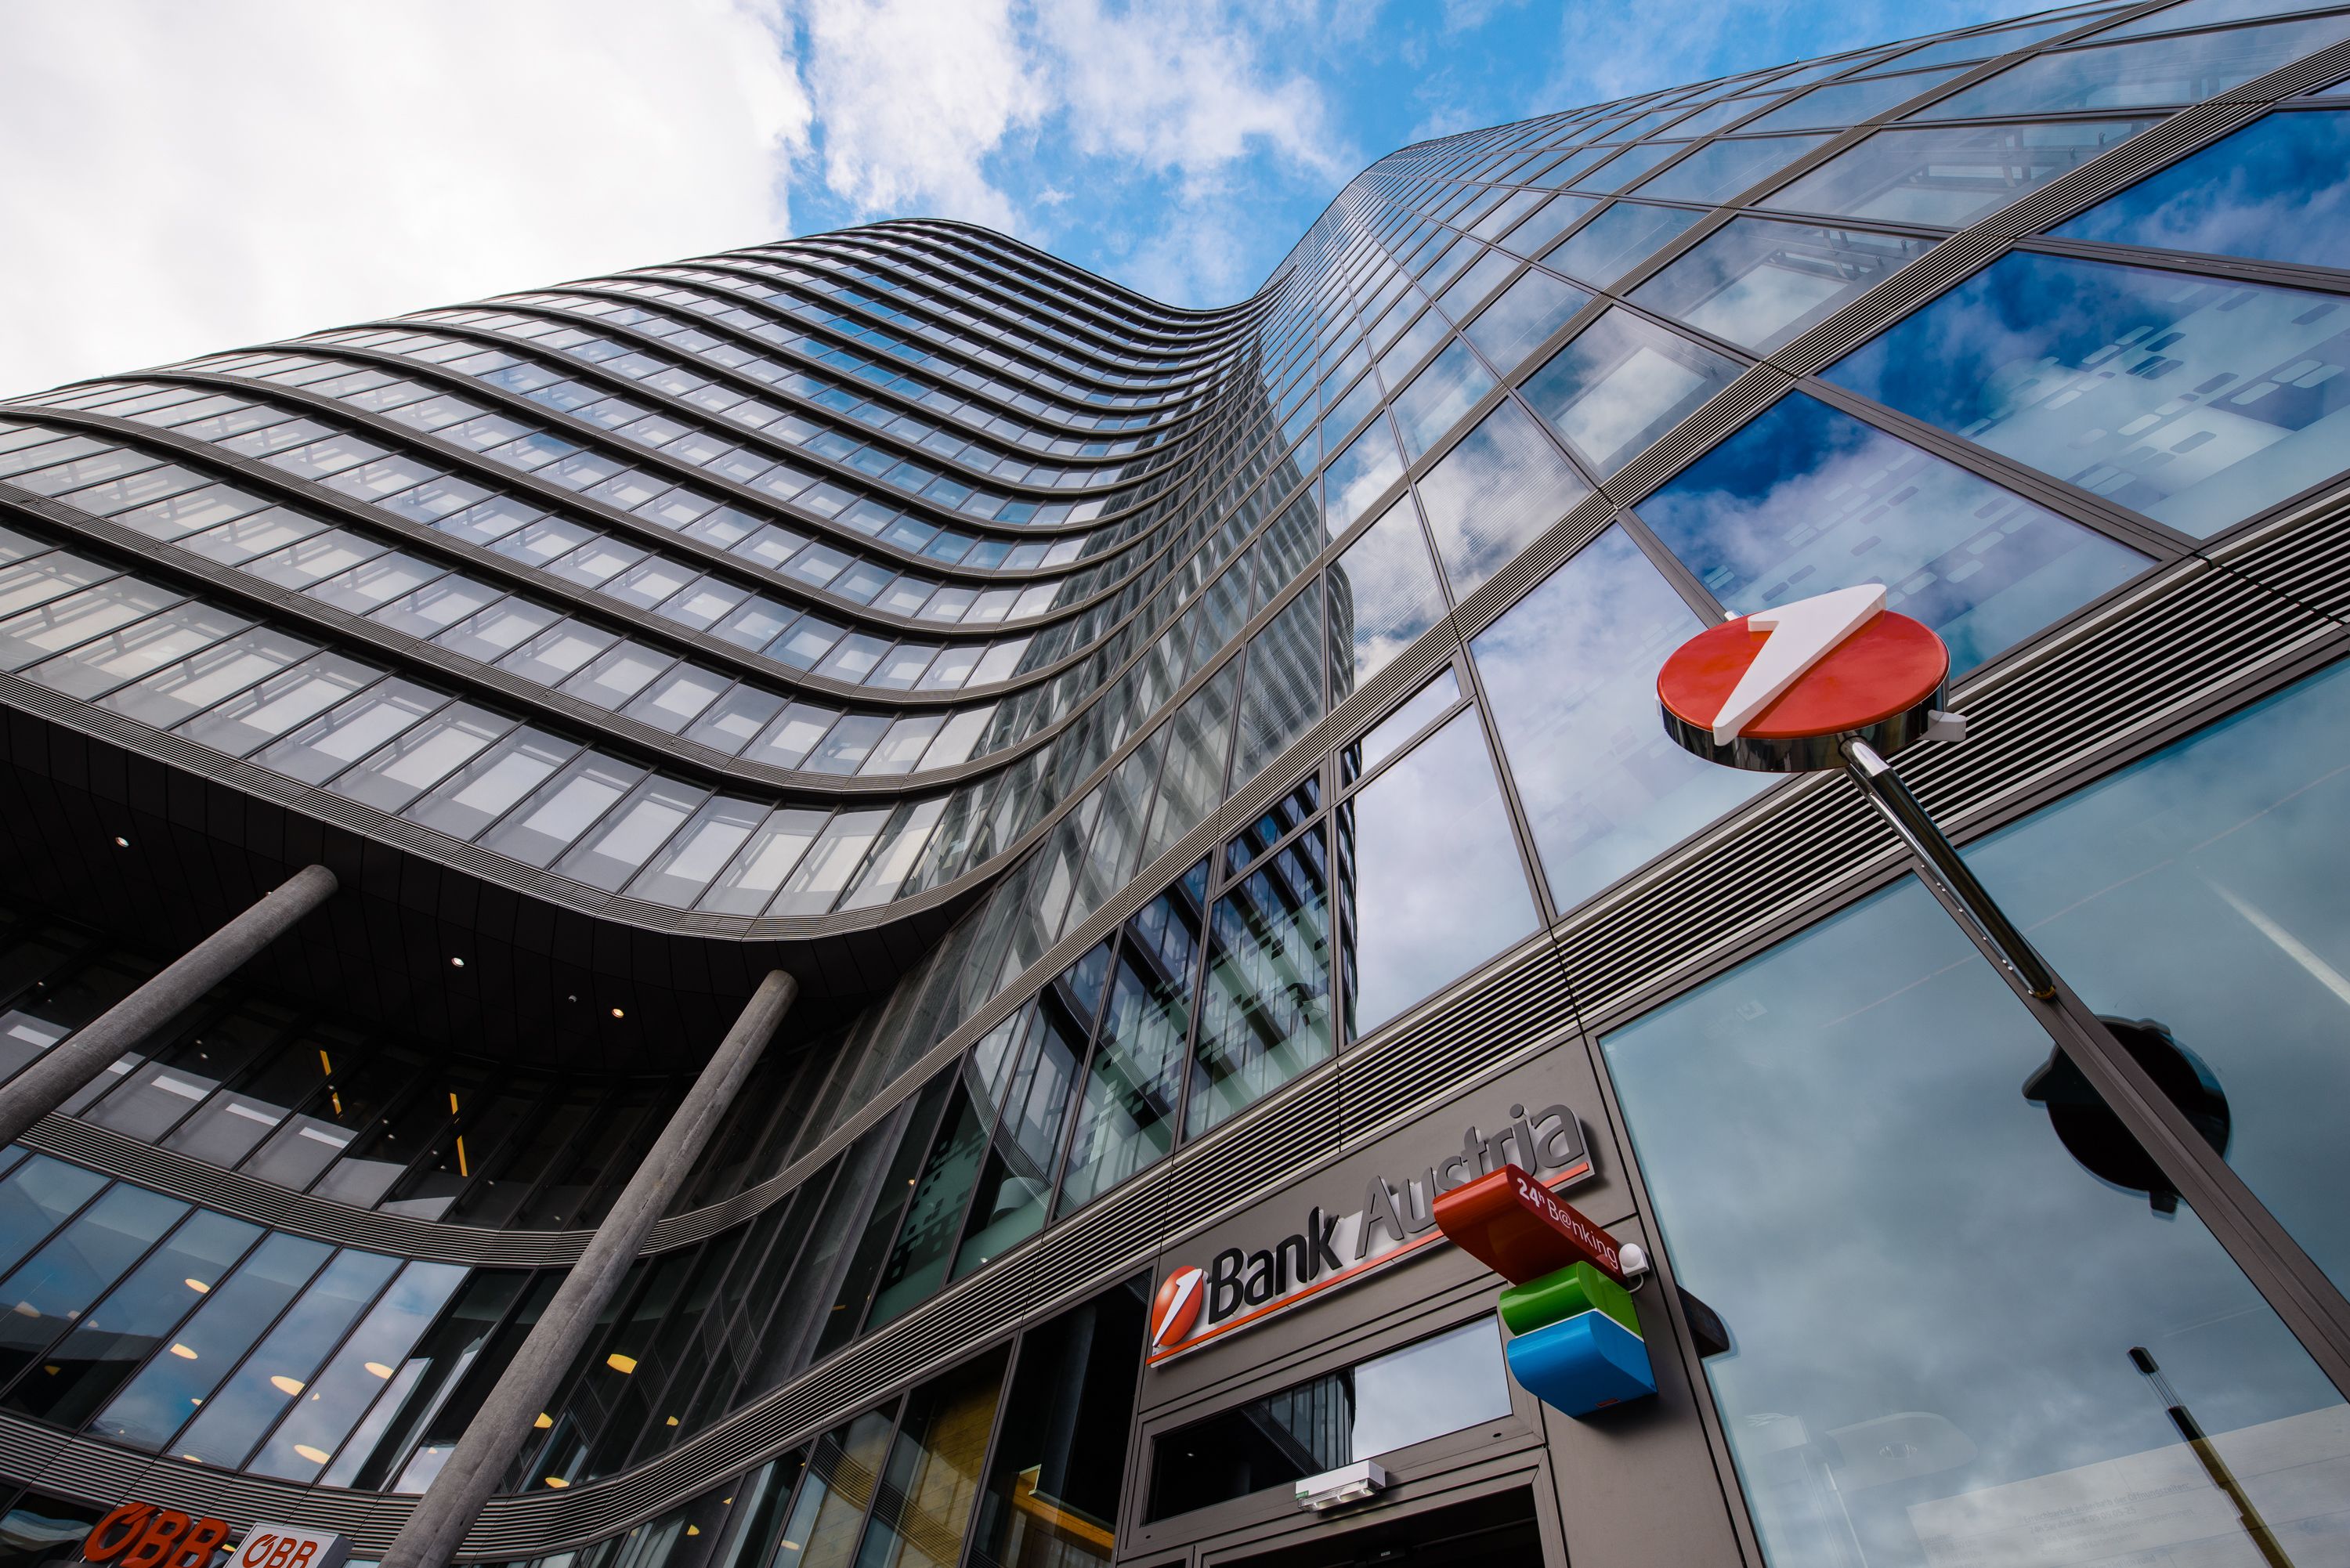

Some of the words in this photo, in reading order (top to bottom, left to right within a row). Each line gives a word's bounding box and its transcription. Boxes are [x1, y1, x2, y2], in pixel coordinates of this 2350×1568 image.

[1209, 1206, 1343, 1325] Bank
[1354, 1103, 1585, 1260] Austria
[1546, 1198, 1619, 1270] B@nking
